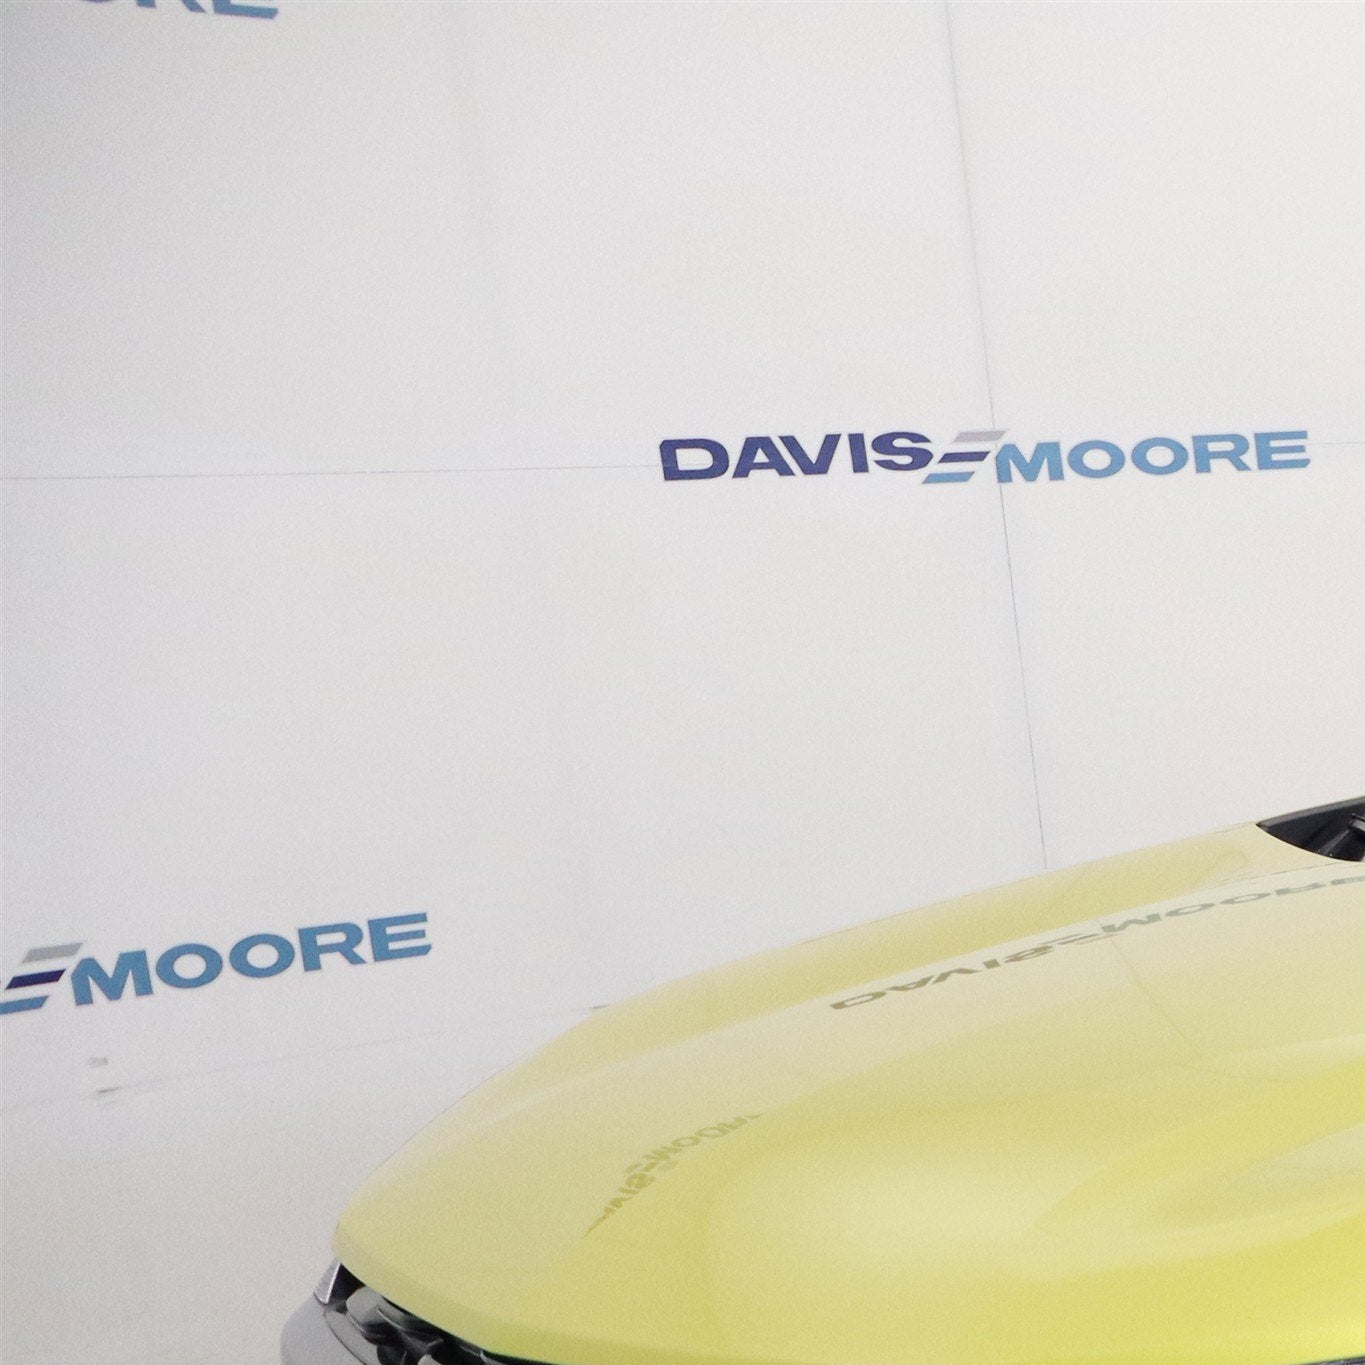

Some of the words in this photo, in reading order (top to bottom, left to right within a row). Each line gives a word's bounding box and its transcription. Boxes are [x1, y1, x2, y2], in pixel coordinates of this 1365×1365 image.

[659, 430, 934, 482] DAVIS
[995, 430, 1311, 484] MOORE
[71, 912, 432, 1007] MOORE
